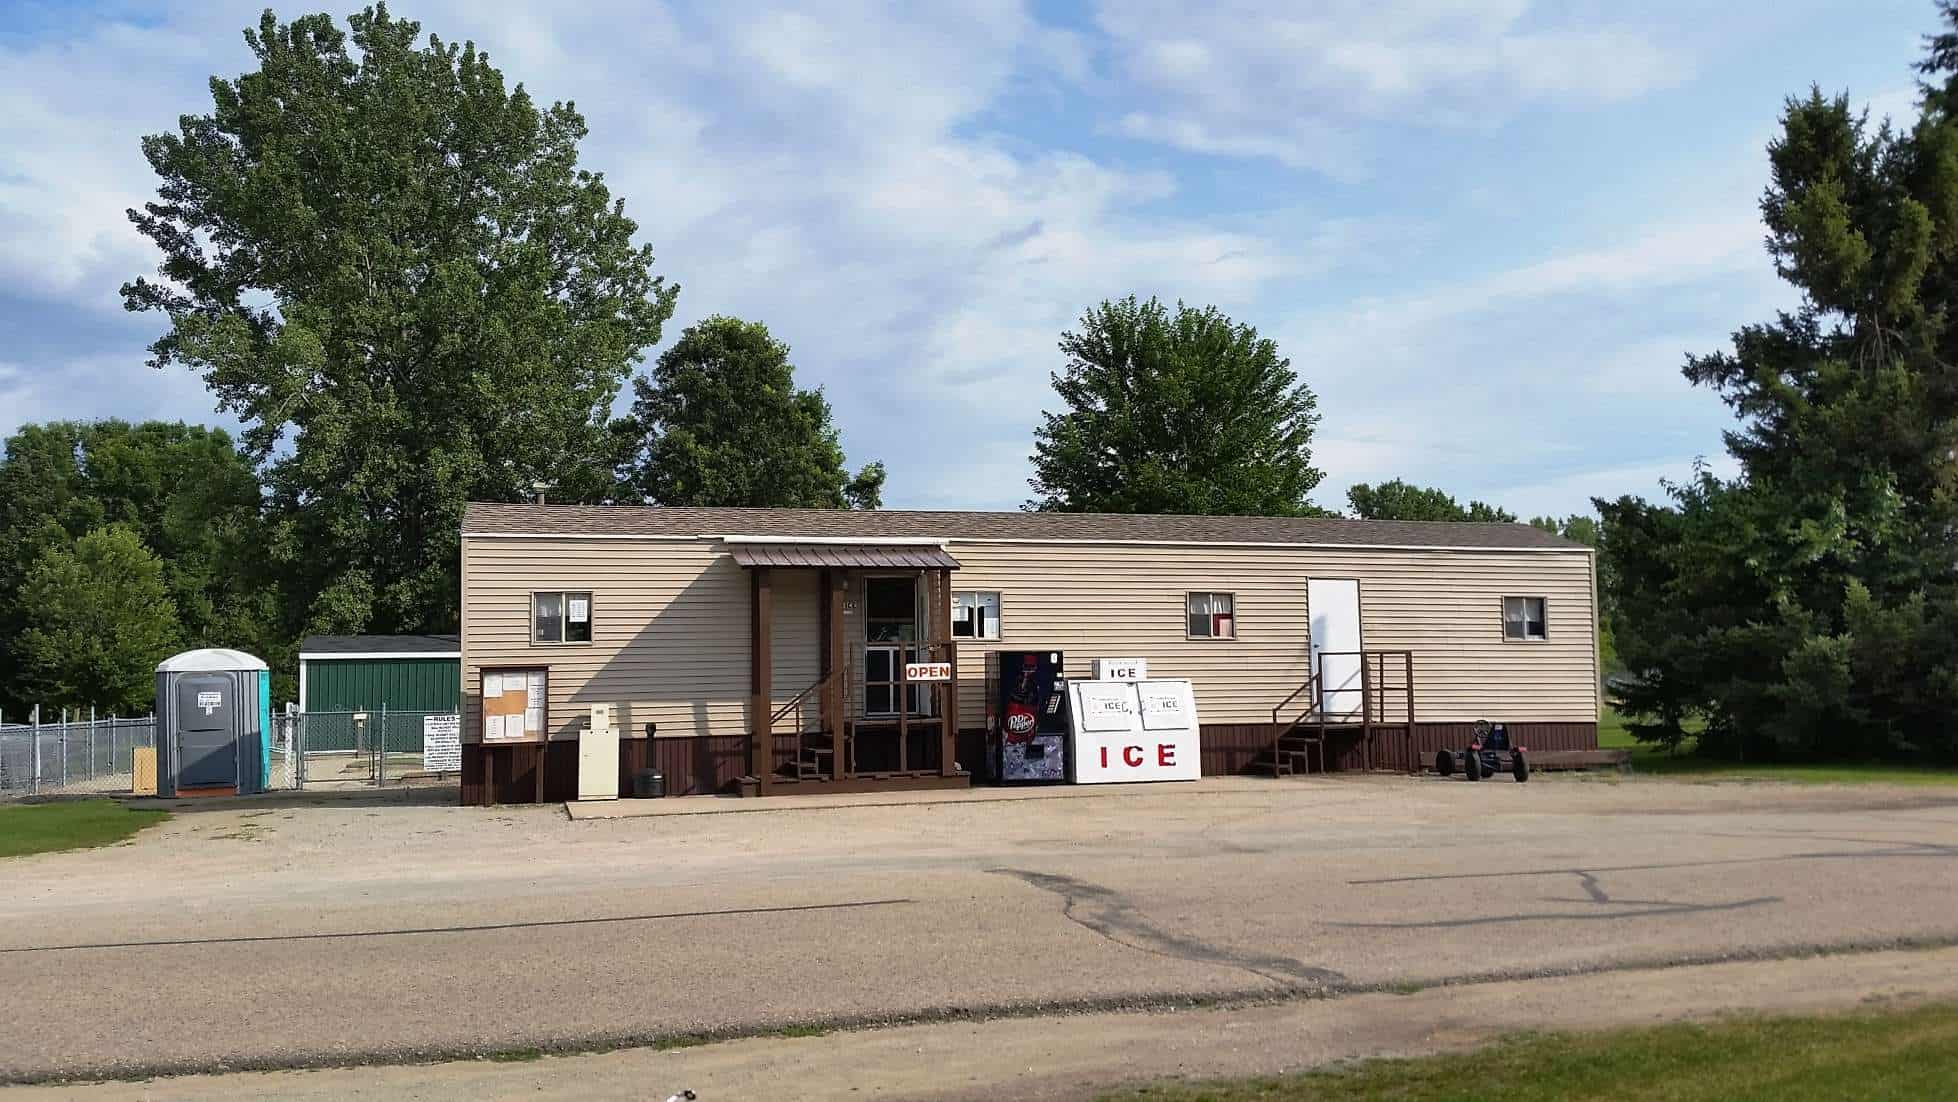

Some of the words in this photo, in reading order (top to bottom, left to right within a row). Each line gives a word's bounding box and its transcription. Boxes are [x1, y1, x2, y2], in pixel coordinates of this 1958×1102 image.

[907, 665, 949, 678] OPEN
[1110, 668, 1136, 678] ICE
[1104, 702, 1121, 710] ICE
[1162, 700, 1177, 709] ICE
[1100, 743, 1177, 769] ICE
